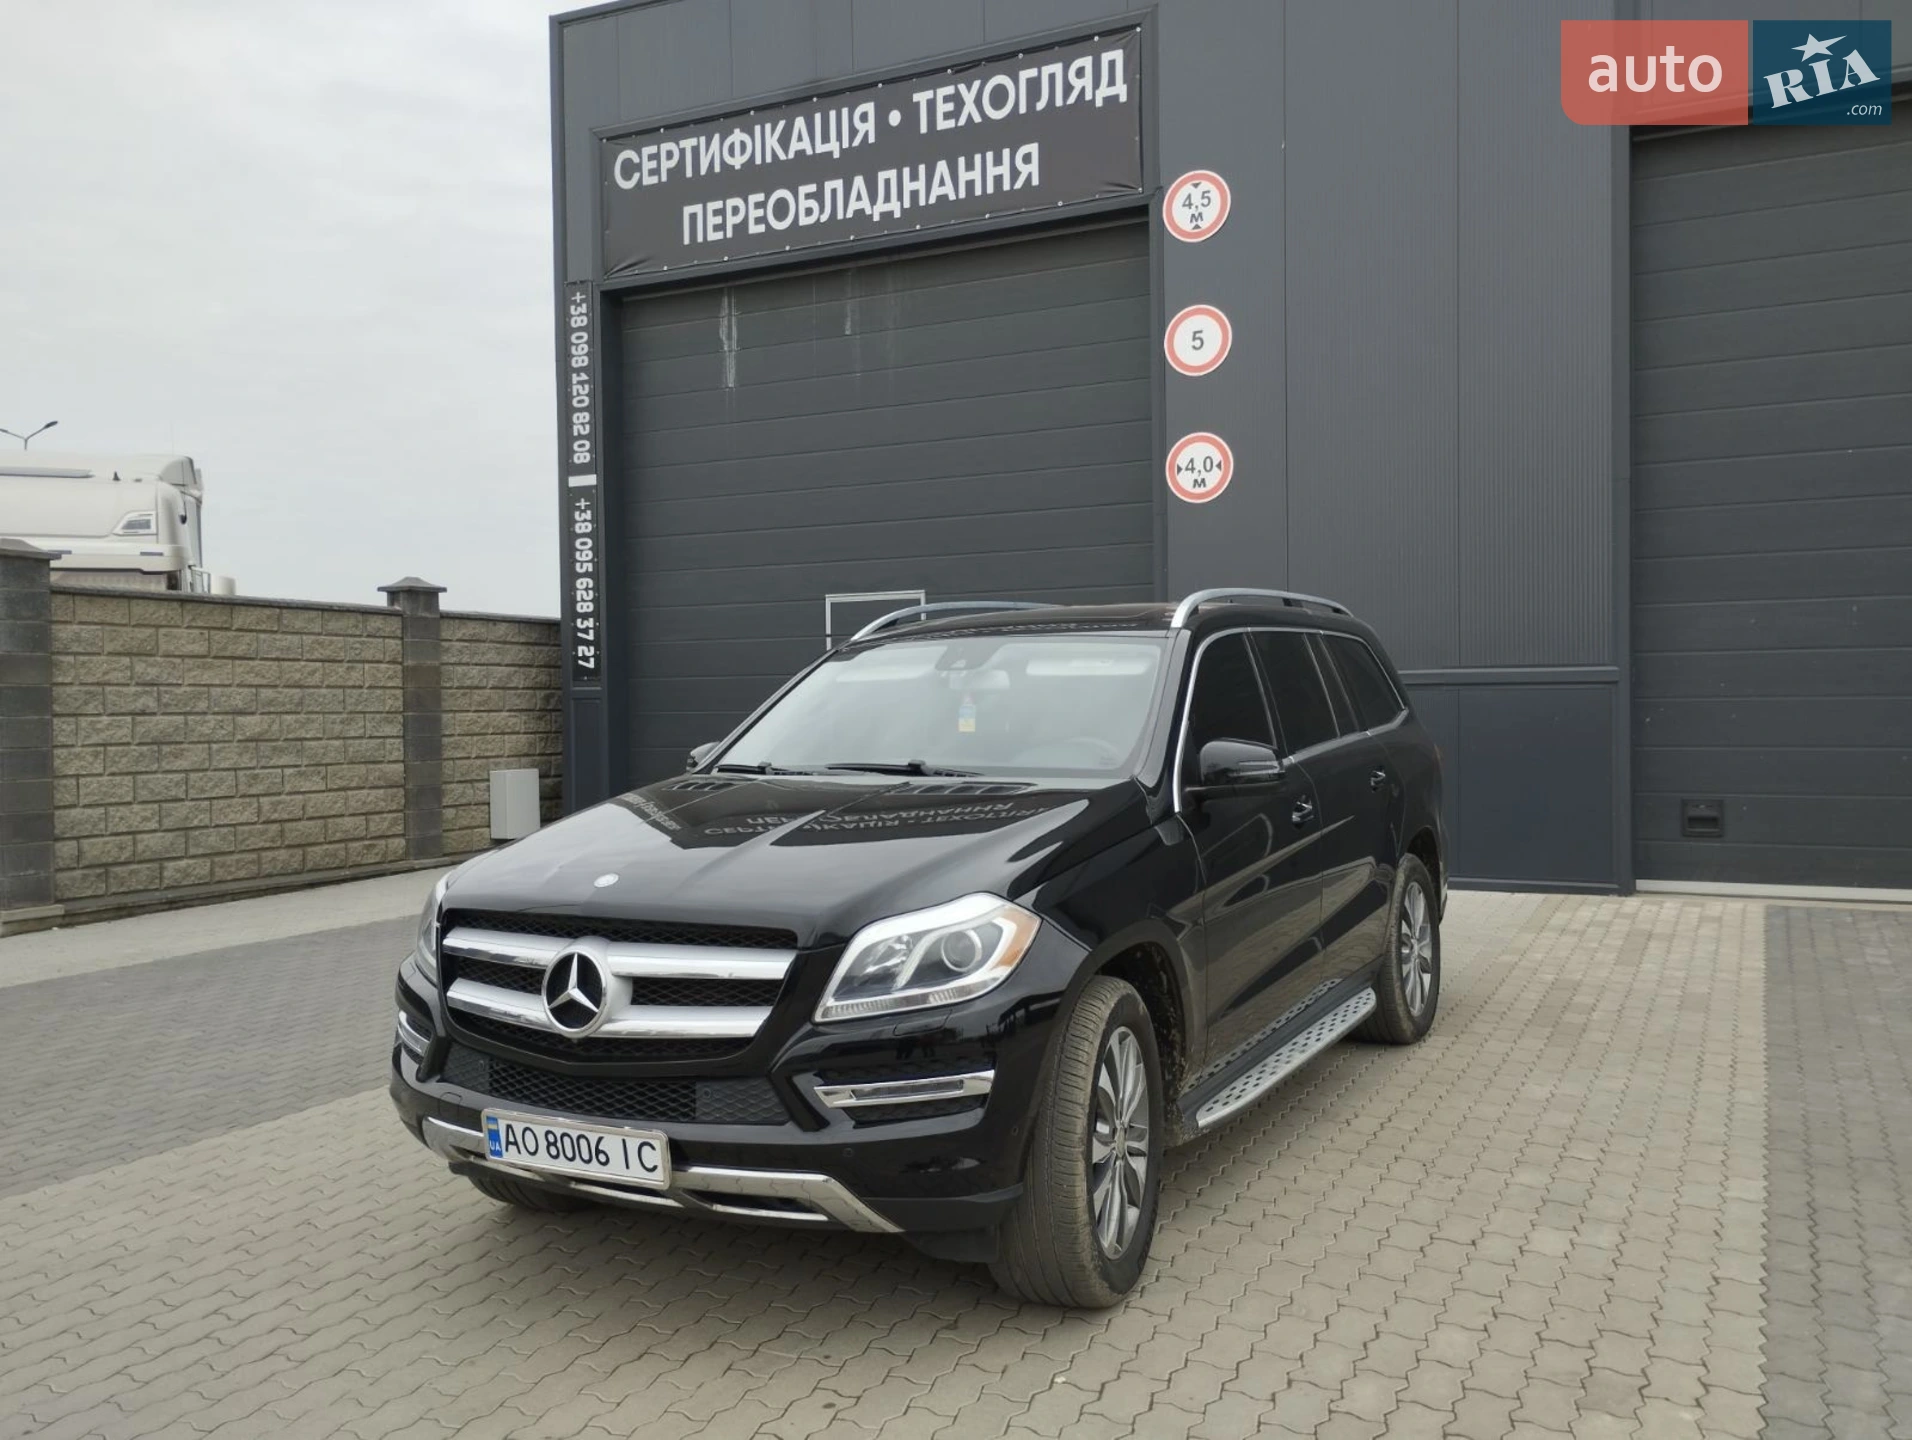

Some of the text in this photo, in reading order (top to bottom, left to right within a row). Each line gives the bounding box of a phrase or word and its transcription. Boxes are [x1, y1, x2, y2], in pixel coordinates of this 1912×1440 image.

[613, 48, 1128, 191] СЕРТИФІКАЦІЯ ТЕХОГЛЯД
[682, 142, 1041, 246] ПЕРЕОБЛАДНАННЯ
[1182, 190, 1211, 211] 4,5
[1191, 330, 1205, 351] 5
[570, 292, 591, 464] +38 098 120 82 08
[1184, 456, 1214, 476] 4,0
[574, 498, 595, 669] +38 095 628 37 27
[489, 1140, 501, 1151] UA
[505, 1124, 539, 1156] AO
[544, 1130, 610, 1166] 8006
